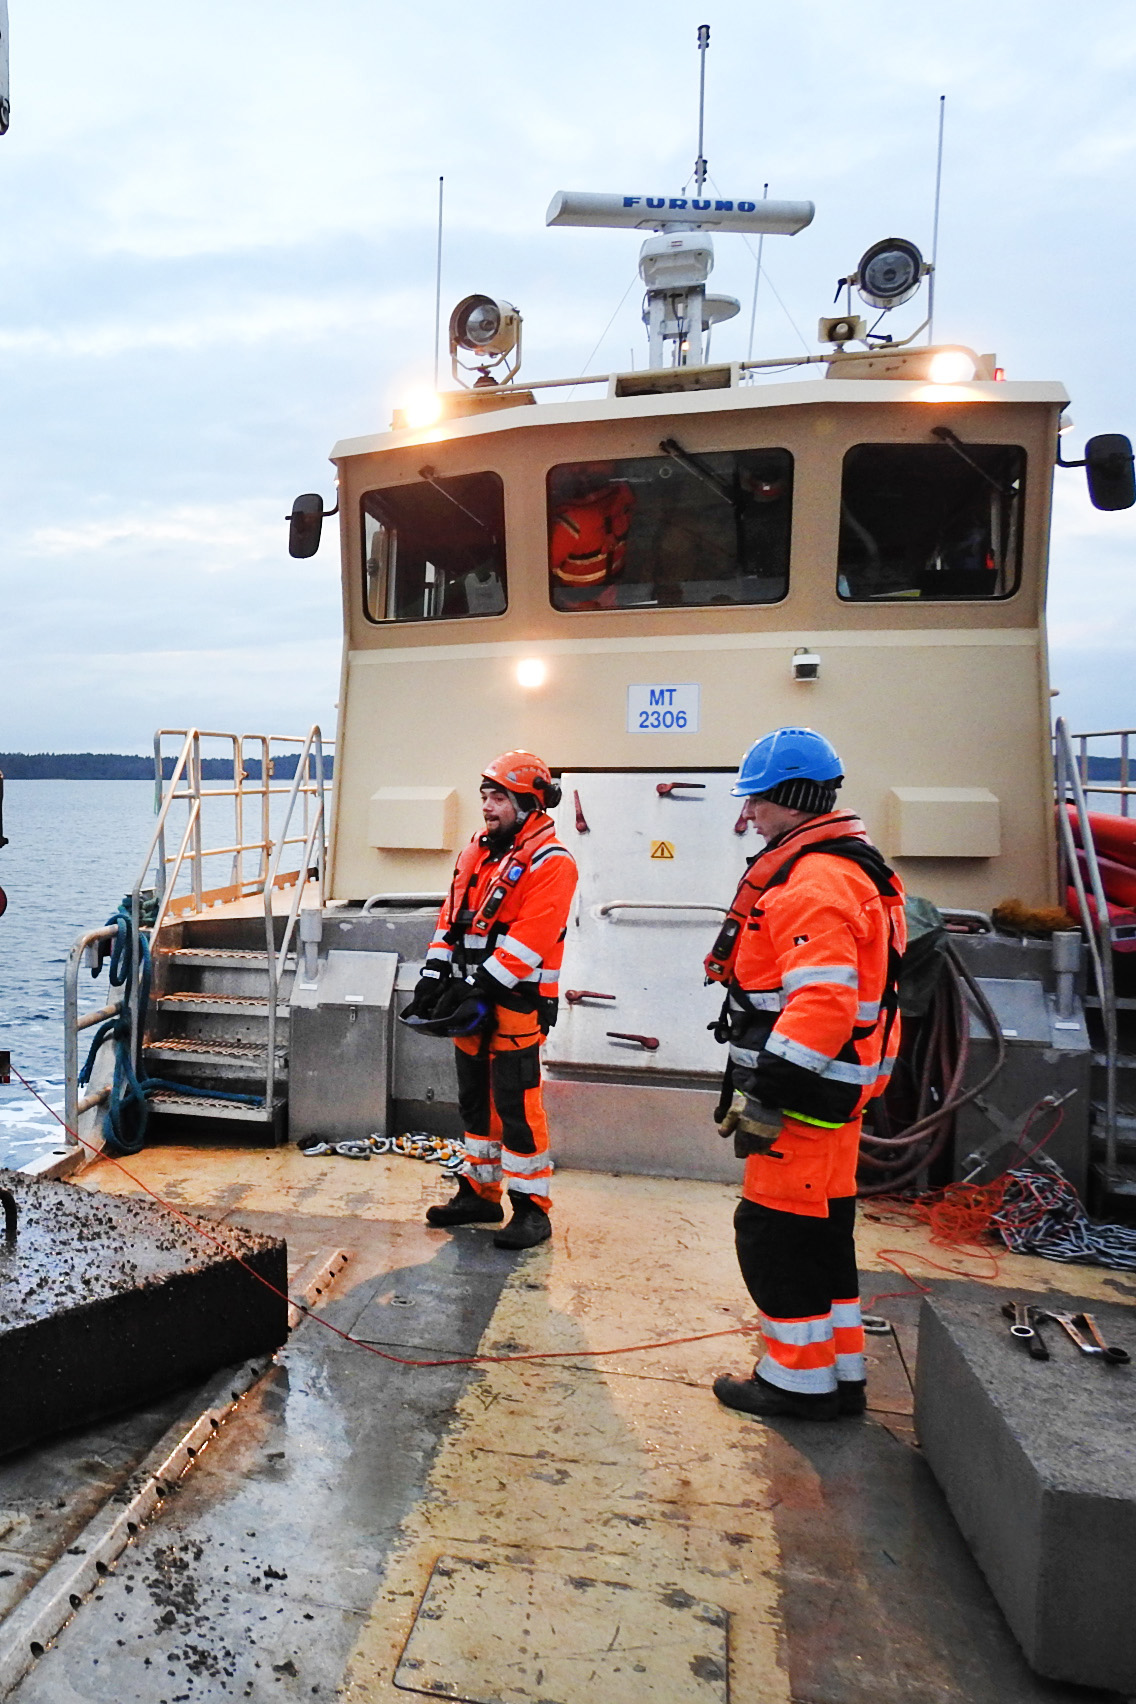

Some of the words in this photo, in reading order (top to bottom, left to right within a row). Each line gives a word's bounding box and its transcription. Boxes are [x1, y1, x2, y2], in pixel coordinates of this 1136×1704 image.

[622, 196, 756, 213] FURUNO
[649, 688, 677, 706] MT
[638, 710, 688, 728] 2306
